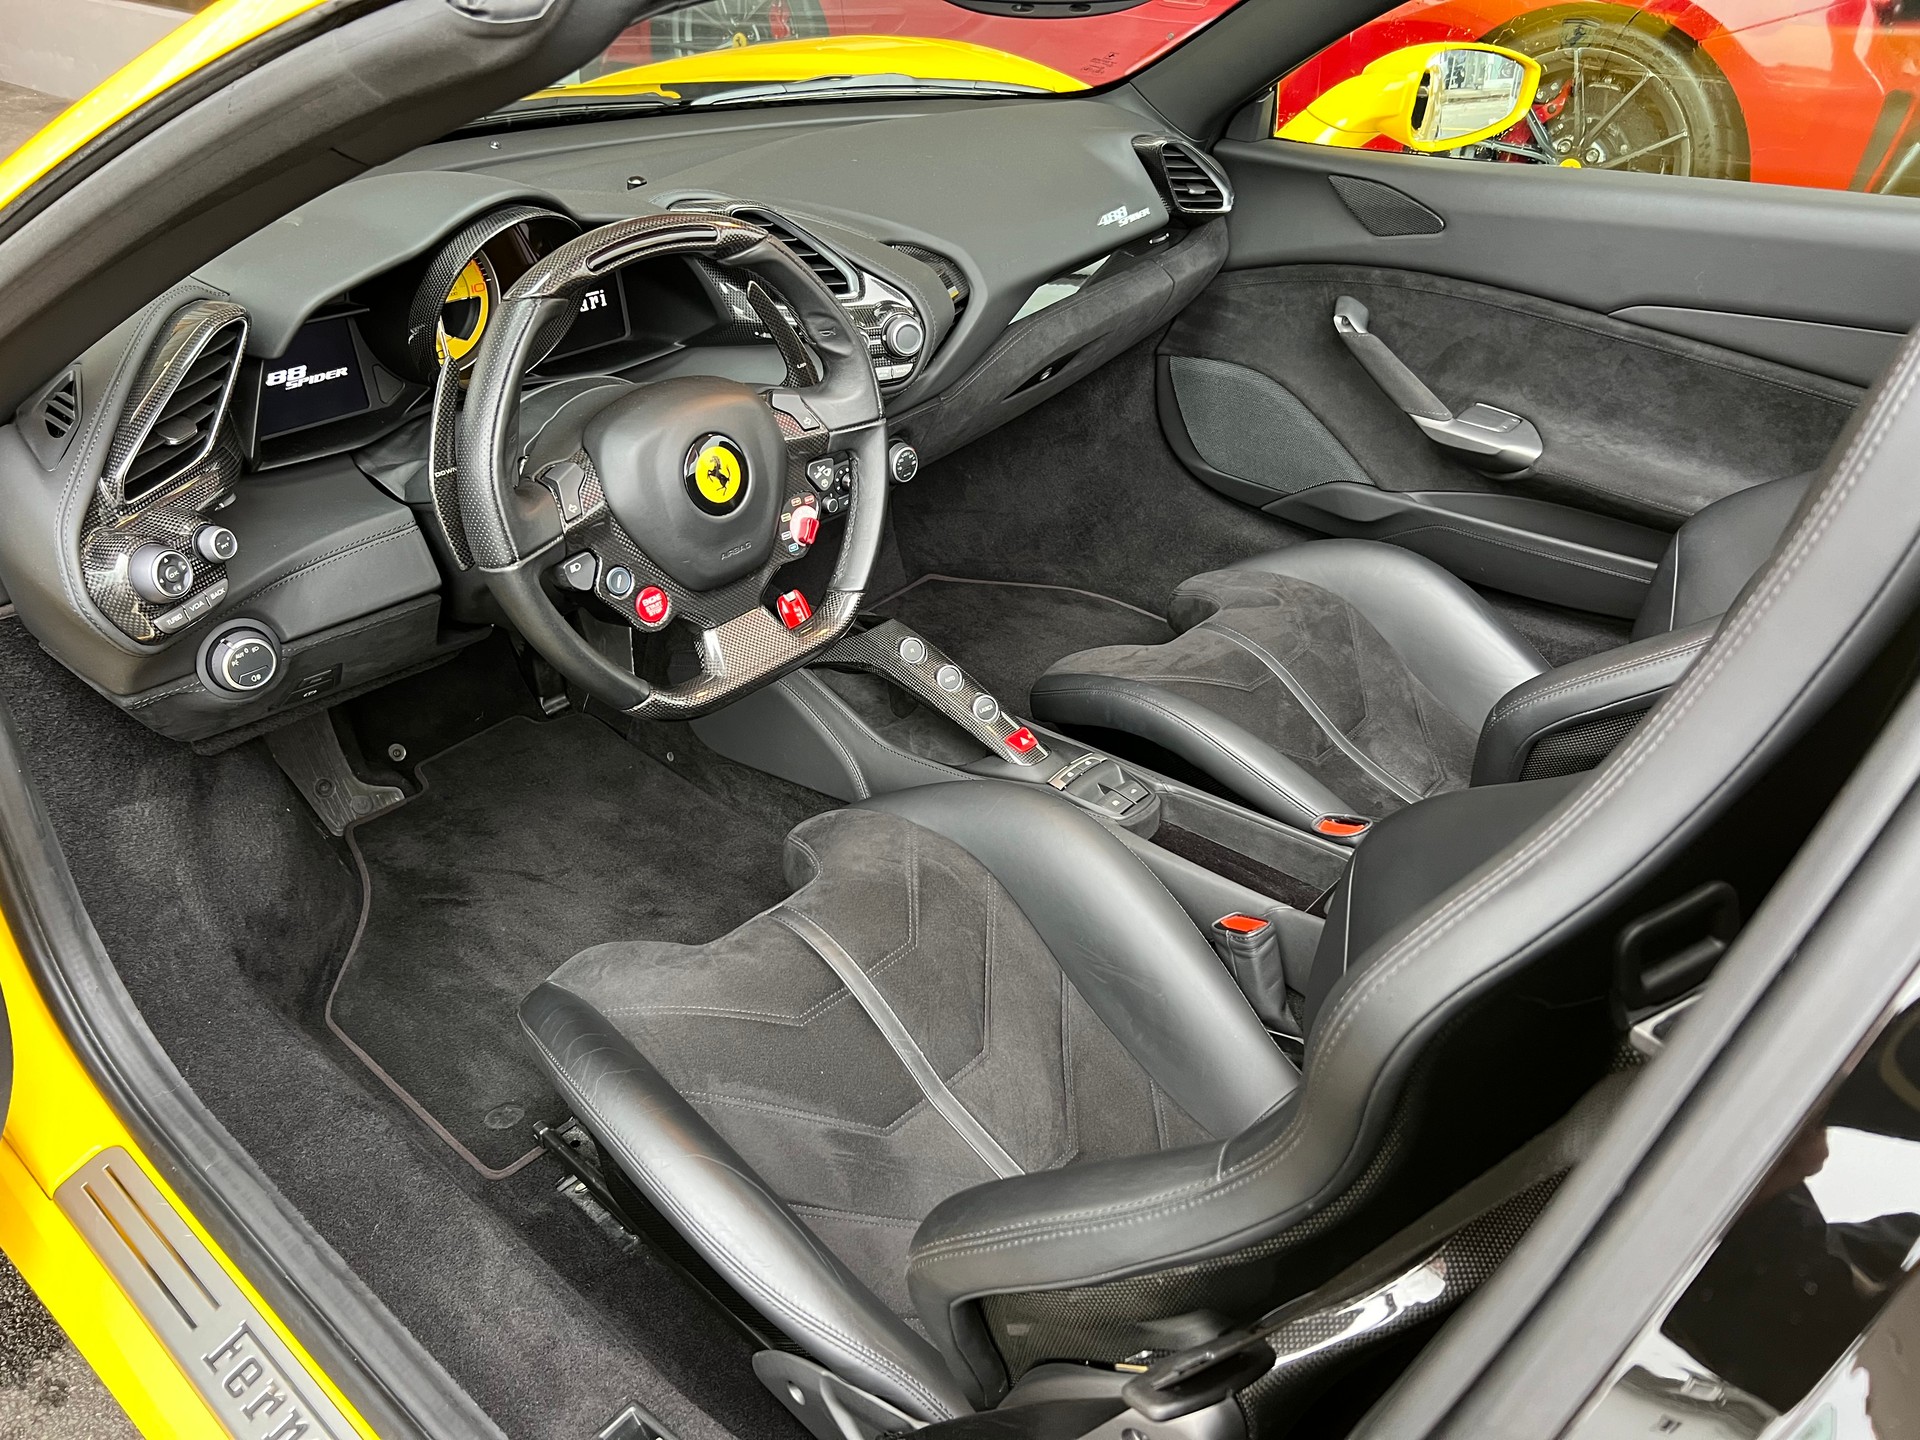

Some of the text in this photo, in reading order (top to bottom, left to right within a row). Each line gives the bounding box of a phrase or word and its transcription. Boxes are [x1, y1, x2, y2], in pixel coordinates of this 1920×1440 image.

[1097, 205, 1128, 226] 488
[1118, 207, 1151, 228] SPIDER
[265, 364, 308, 387] 88
[285, 366, 349, 391] SPIDER
[210, 587, 226, 600] BACK
[641, 592, 663, 607] ENGINE
[166, 613, 183, 626] TURBO
